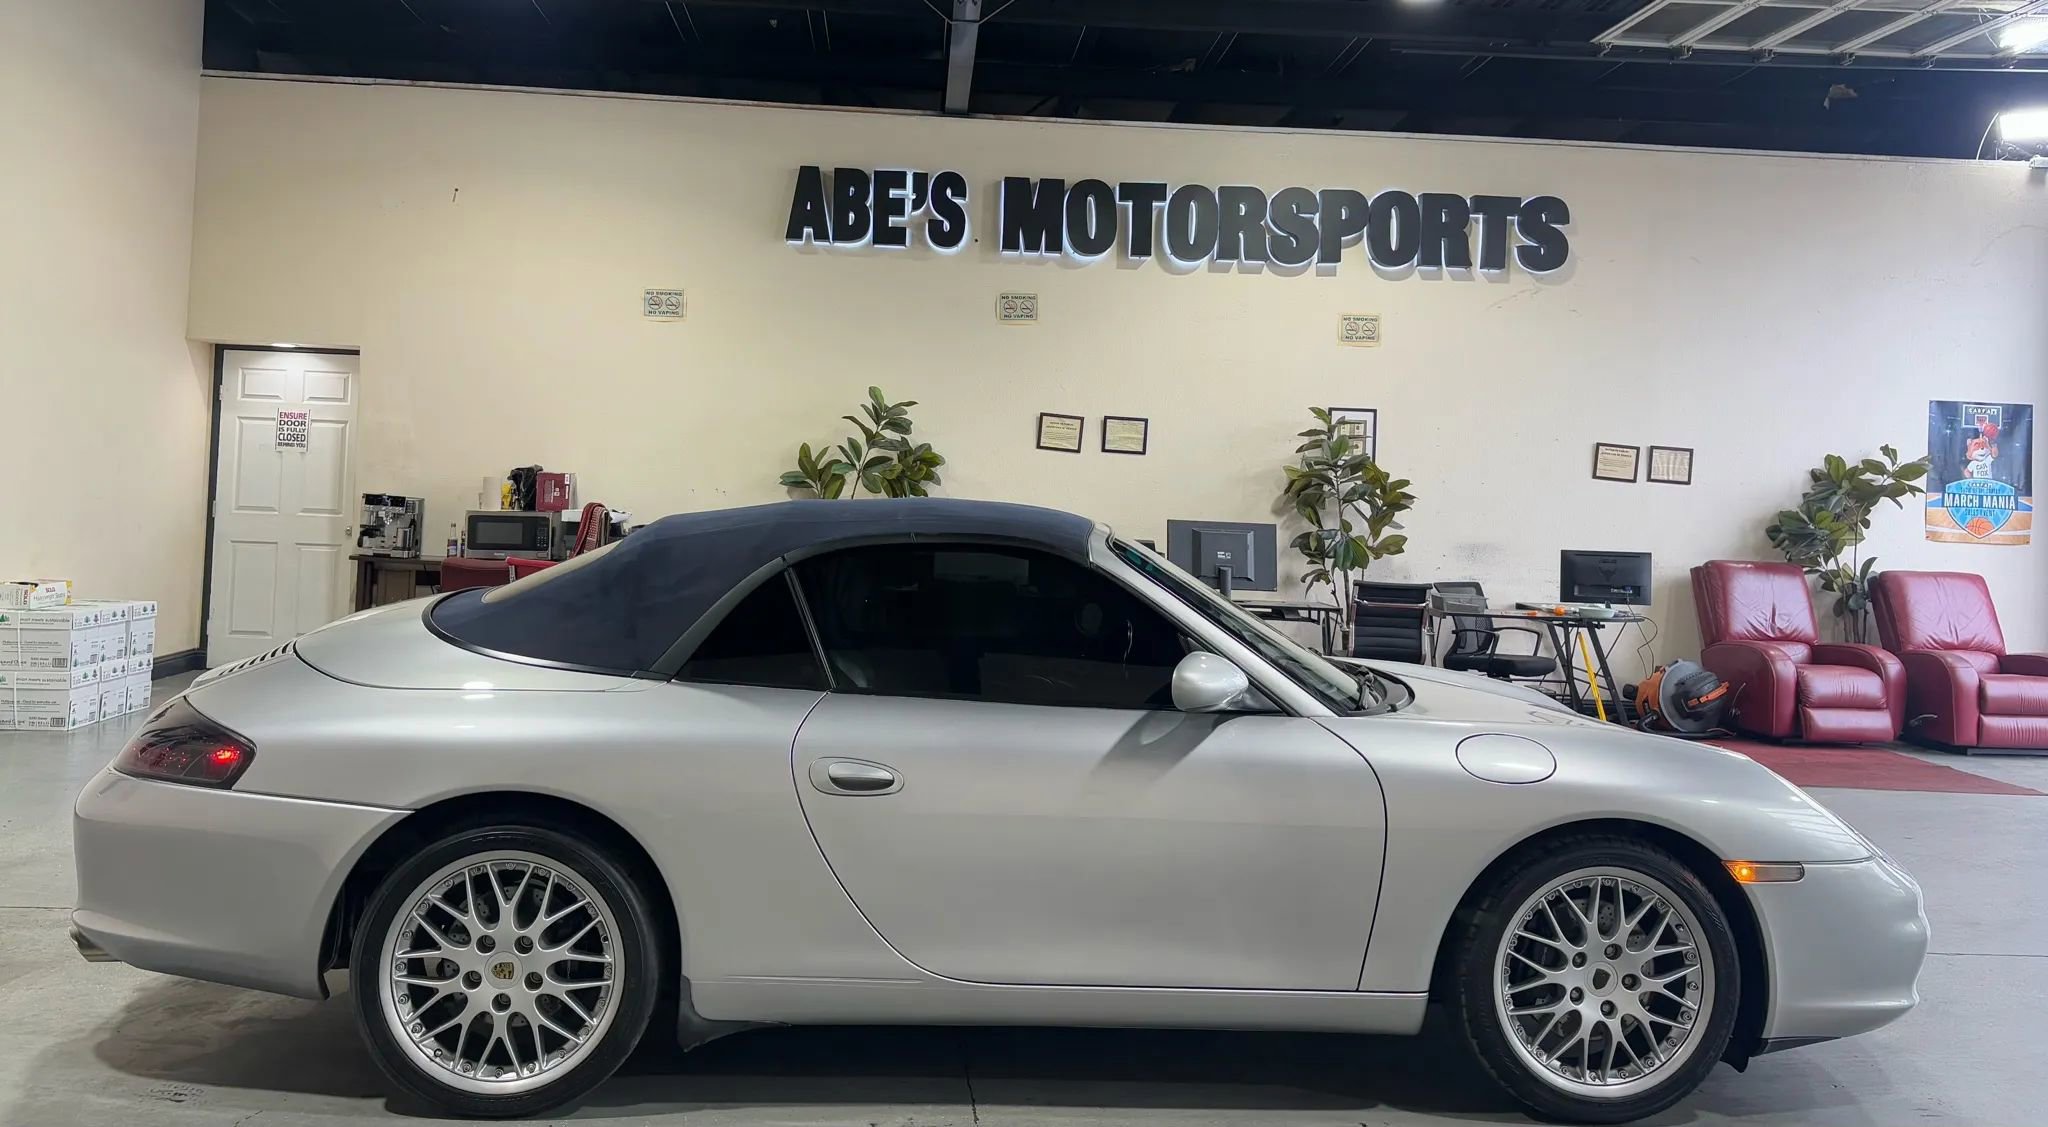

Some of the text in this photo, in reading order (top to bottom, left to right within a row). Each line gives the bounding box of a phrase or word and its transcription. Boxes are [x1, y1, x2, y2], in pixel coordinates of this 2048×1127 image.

[785, 165, 1571, 275] ABE'S MOTORSPORTS
[279, 411, 308, 420] ENSURE
[278, 432, 306, 442] CLOSED
[1944, 493, 2016, 510] MARCH MANIA
